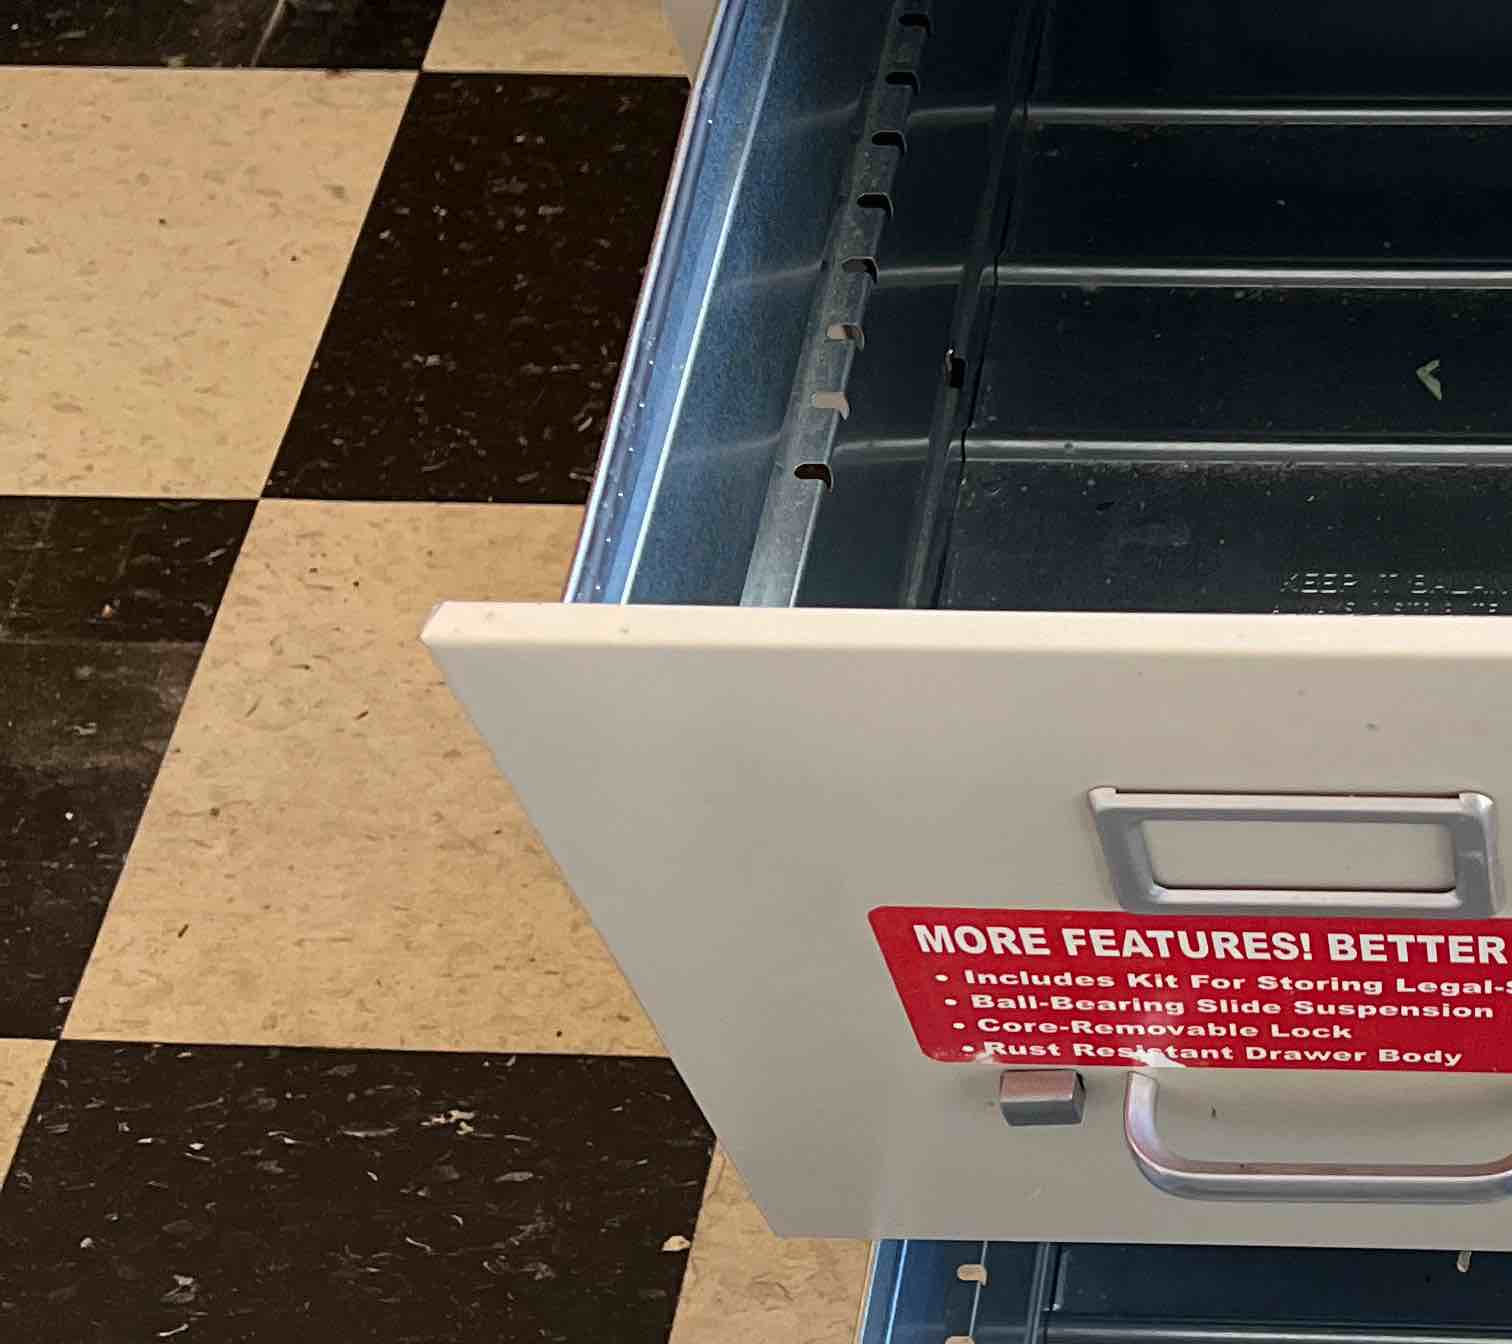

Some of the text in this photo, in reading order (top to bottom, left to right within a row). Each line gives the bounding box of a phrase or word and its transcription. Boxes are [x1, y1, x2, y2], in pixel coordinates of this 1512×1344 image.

[1279, 573, 1359, 594] KEEP
[913, 924, 1051, 957] MORE
[1061, 927, 1312, 962] FEATURES!
[1327, 933, 1507, 966] BETTER
[964, 969, 1115, 989] Includes
[1127, 972, 1178, 990] Kit
[1190, 974, 1246, 991] For
[1257, 975, 1383, 996] Storing
[971, 993, 1495, 1020] Ball-Bearing Slide Suspension
[977, 1018, 1353, 1040] Core-Removable Lock
[983, 1040, 1463, 1068] Rust Resistant Drawer Body
